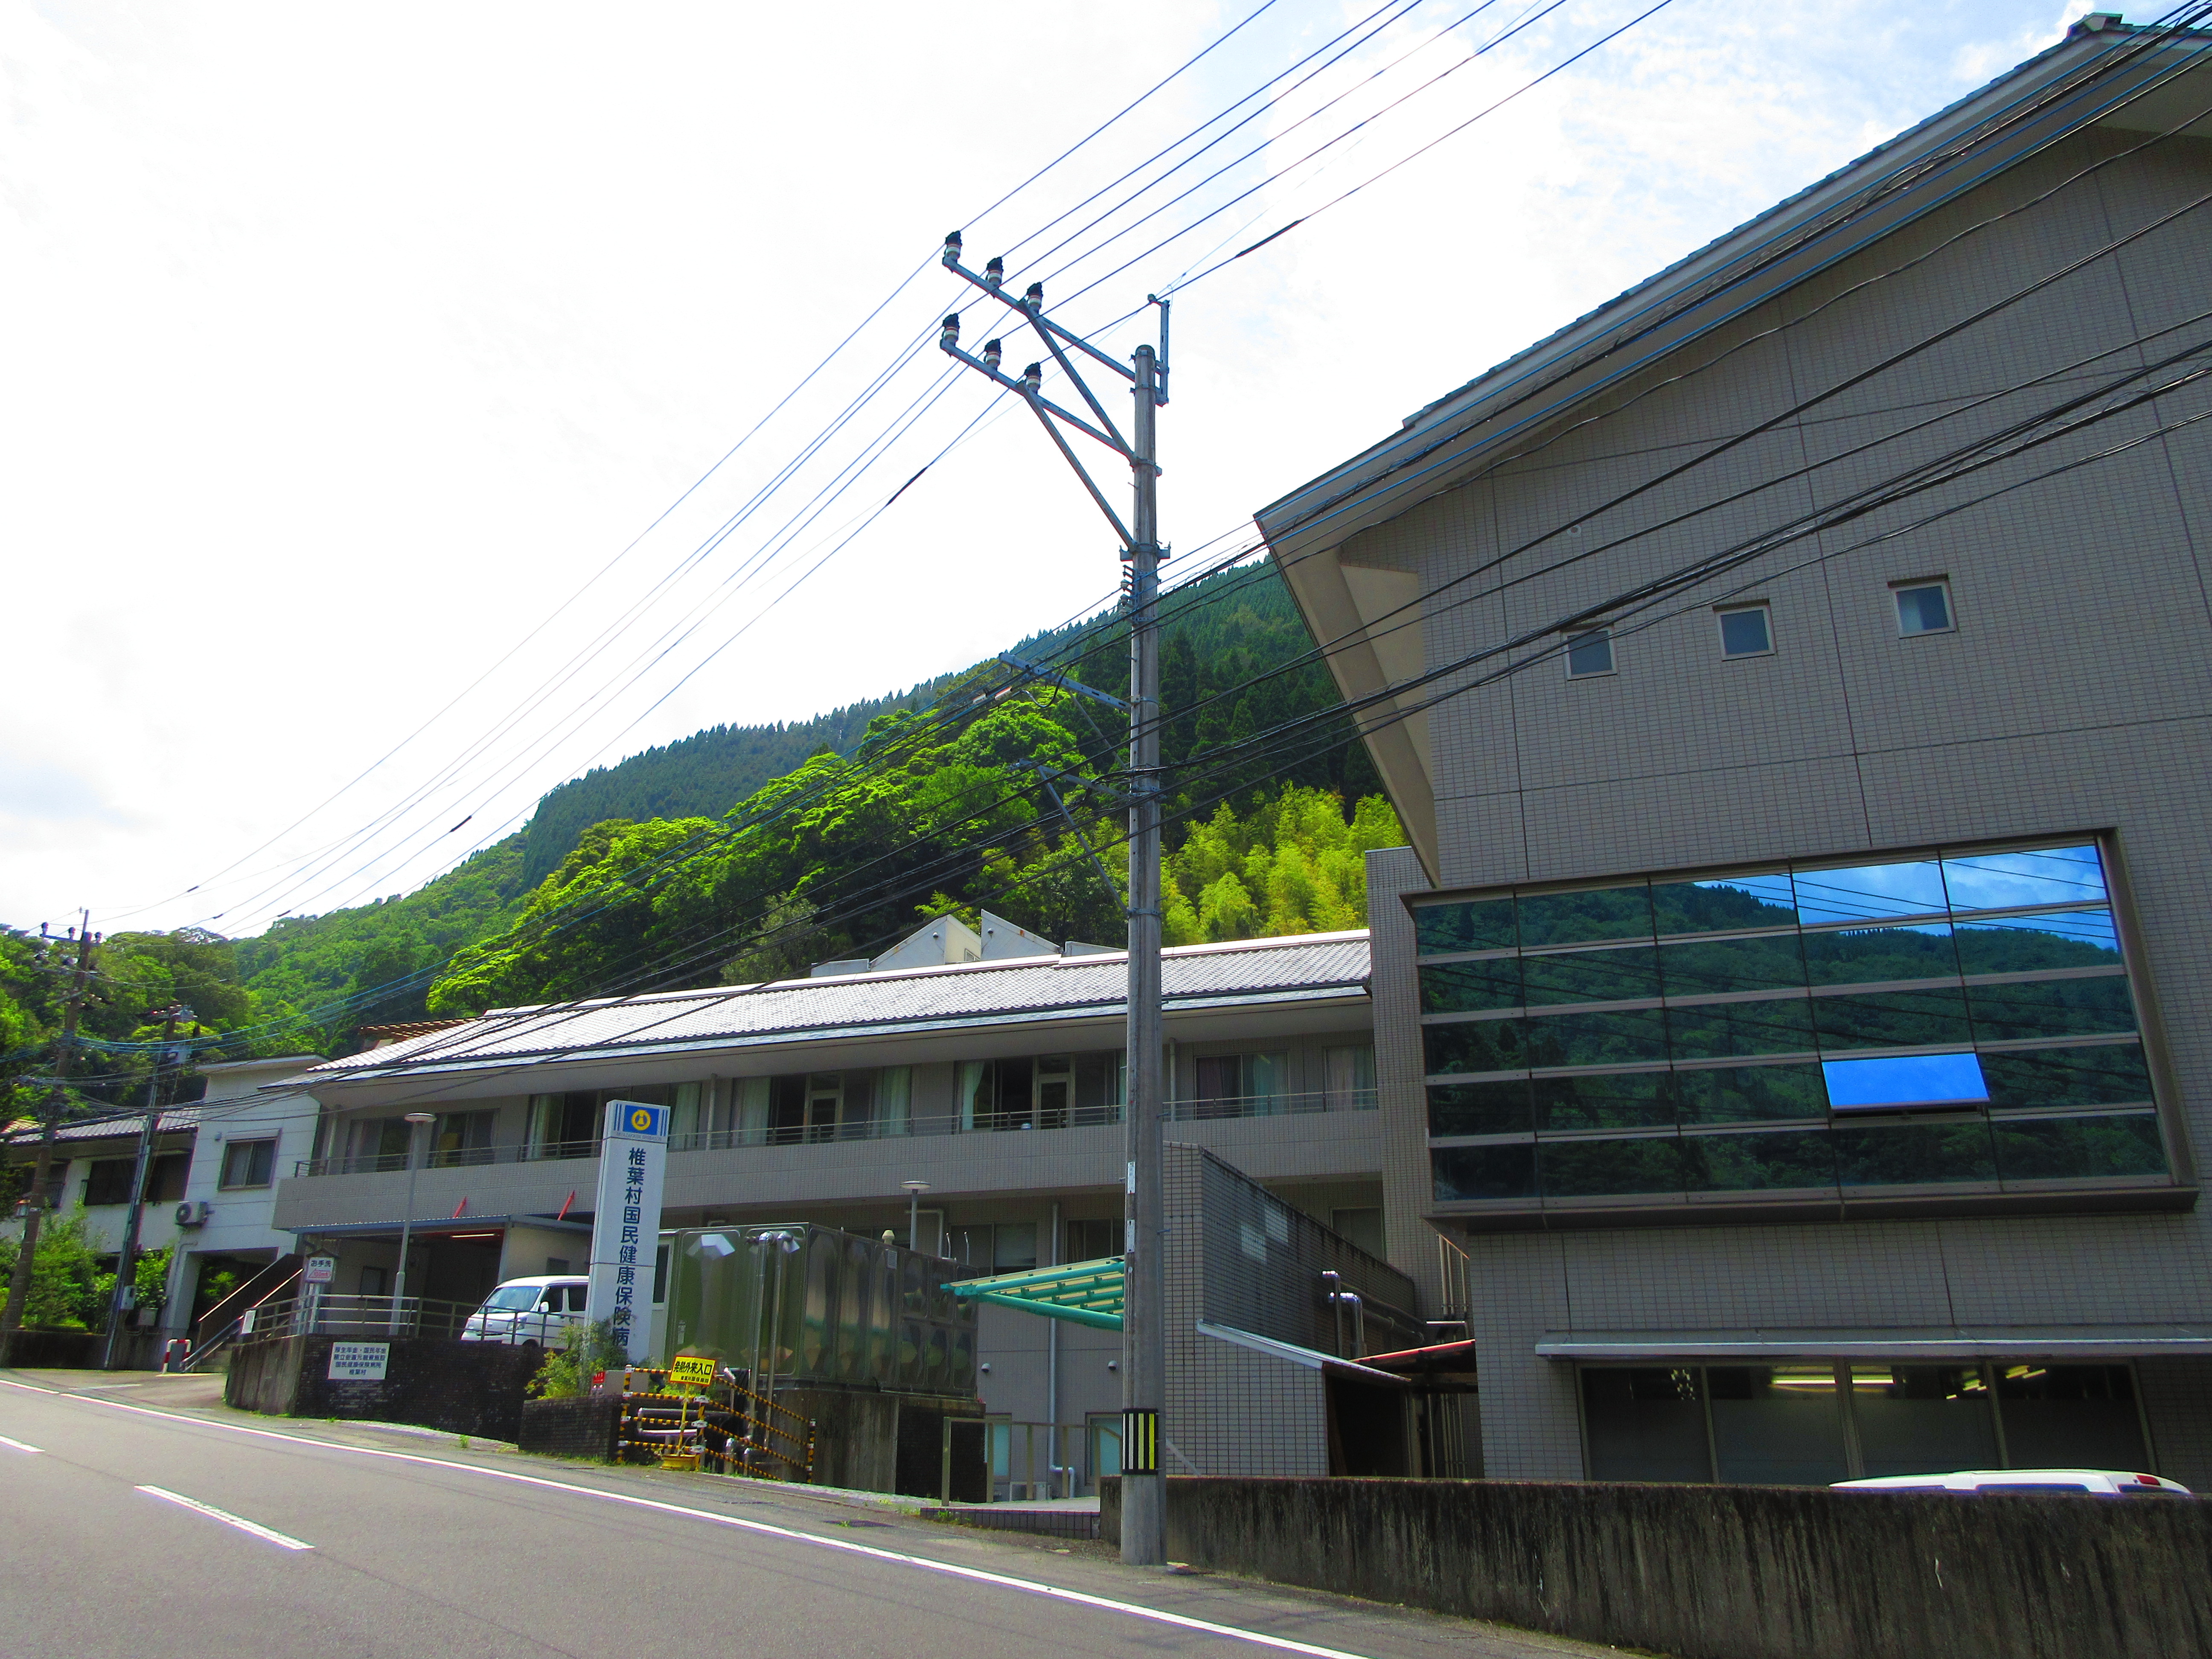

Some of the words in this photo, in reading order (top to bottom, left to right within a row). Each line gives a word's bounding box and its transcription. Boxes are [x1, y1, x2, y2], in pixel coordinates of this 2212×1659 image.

[612, 1147, 646, 1354] 椎葉村国民健康保険病
